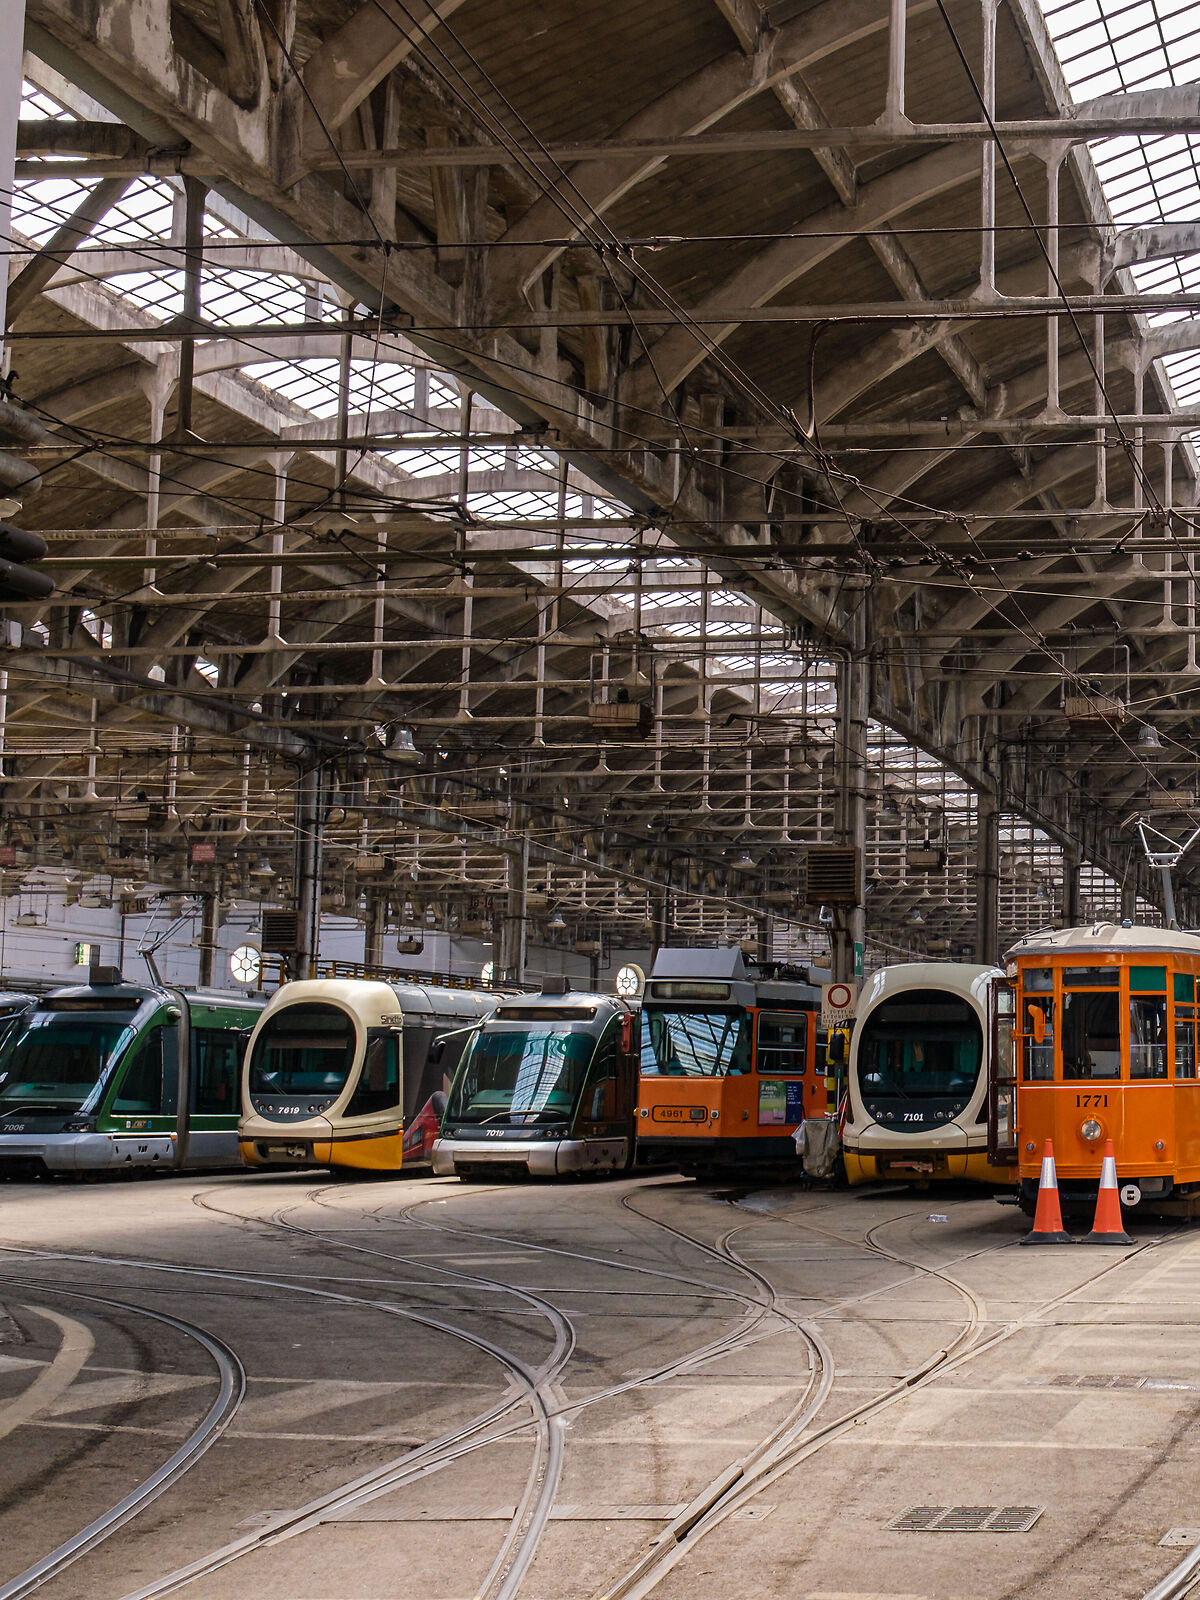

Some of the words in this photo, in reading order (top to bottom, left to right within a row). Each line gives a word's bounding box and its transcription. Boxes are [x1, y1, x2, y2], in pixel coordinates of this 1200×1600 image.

[1076, 1094, 1108, 1107] 1771
[278, 1106, 300, 1114] 7619
[660, 1110, 683, 1118] 4961
[903, 1113, 924, 1121] 7101
[486, 1129, 505, 1137] 7019
